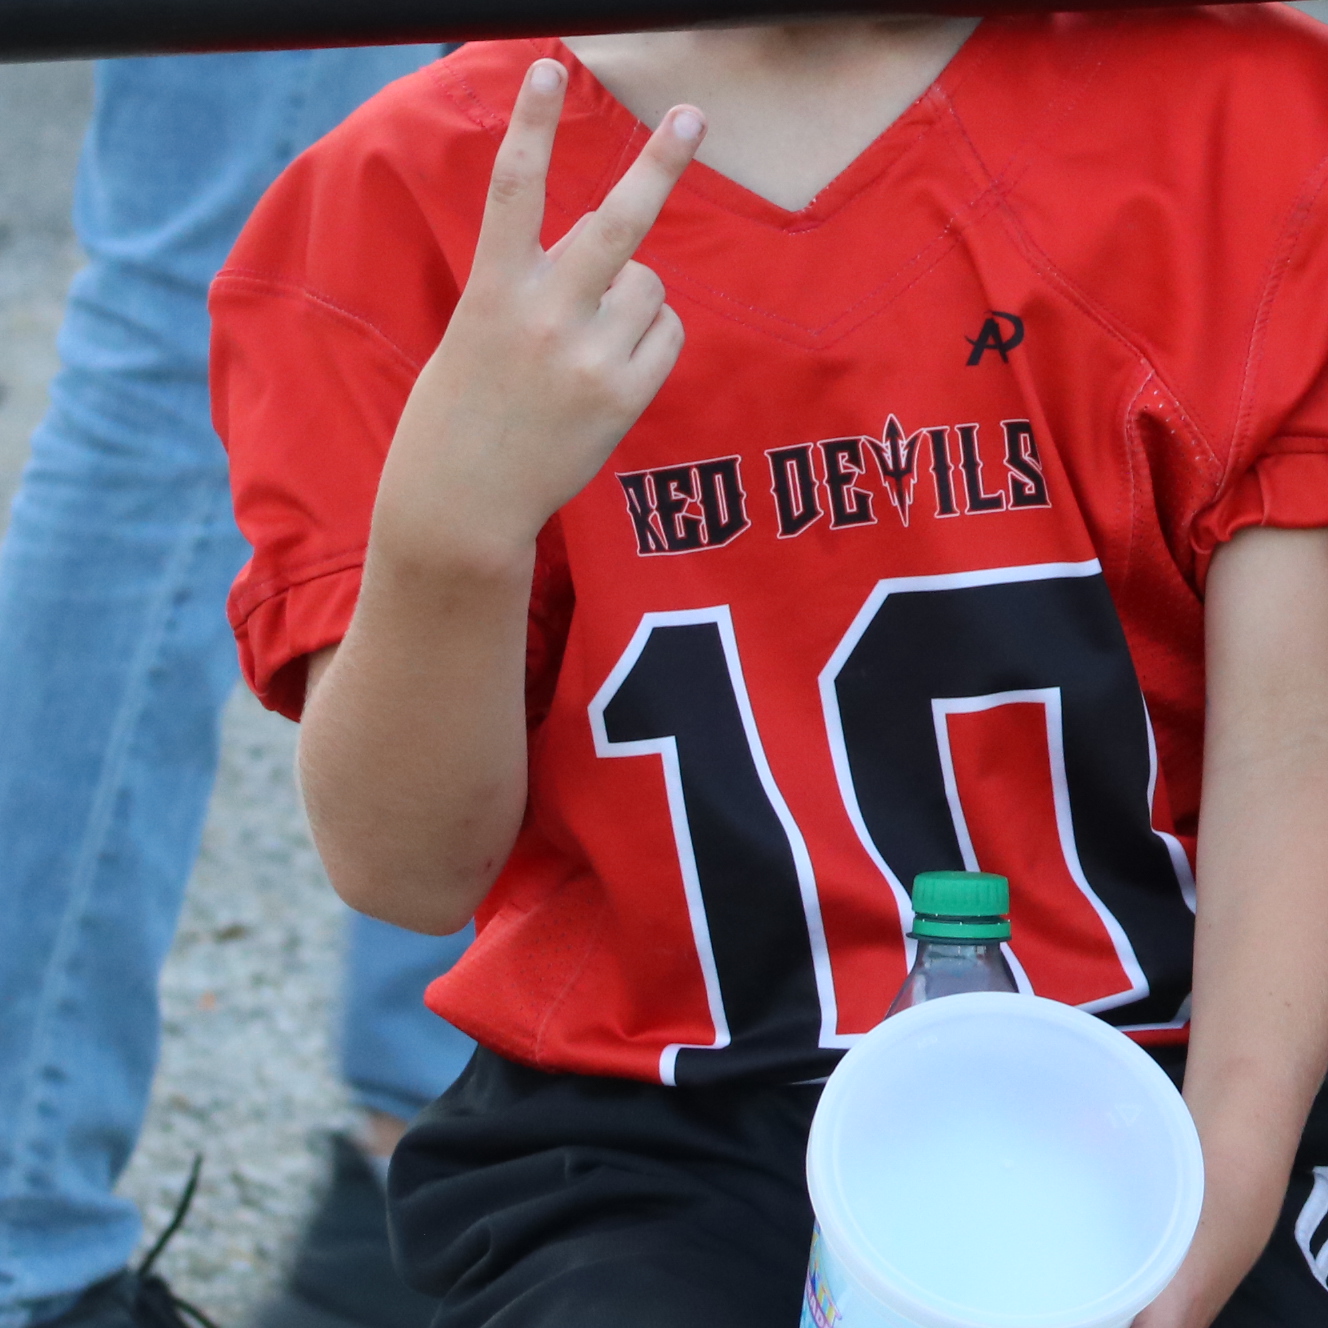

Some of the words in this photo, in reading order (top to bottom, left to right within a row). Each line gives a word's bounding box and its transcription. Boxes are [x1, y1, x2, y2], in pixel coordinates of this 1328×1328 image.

[614, 454, 752, 557] RED
[763, 413, 1052, 539] DEVILS
[587, 557, 1196, 1086] 10
